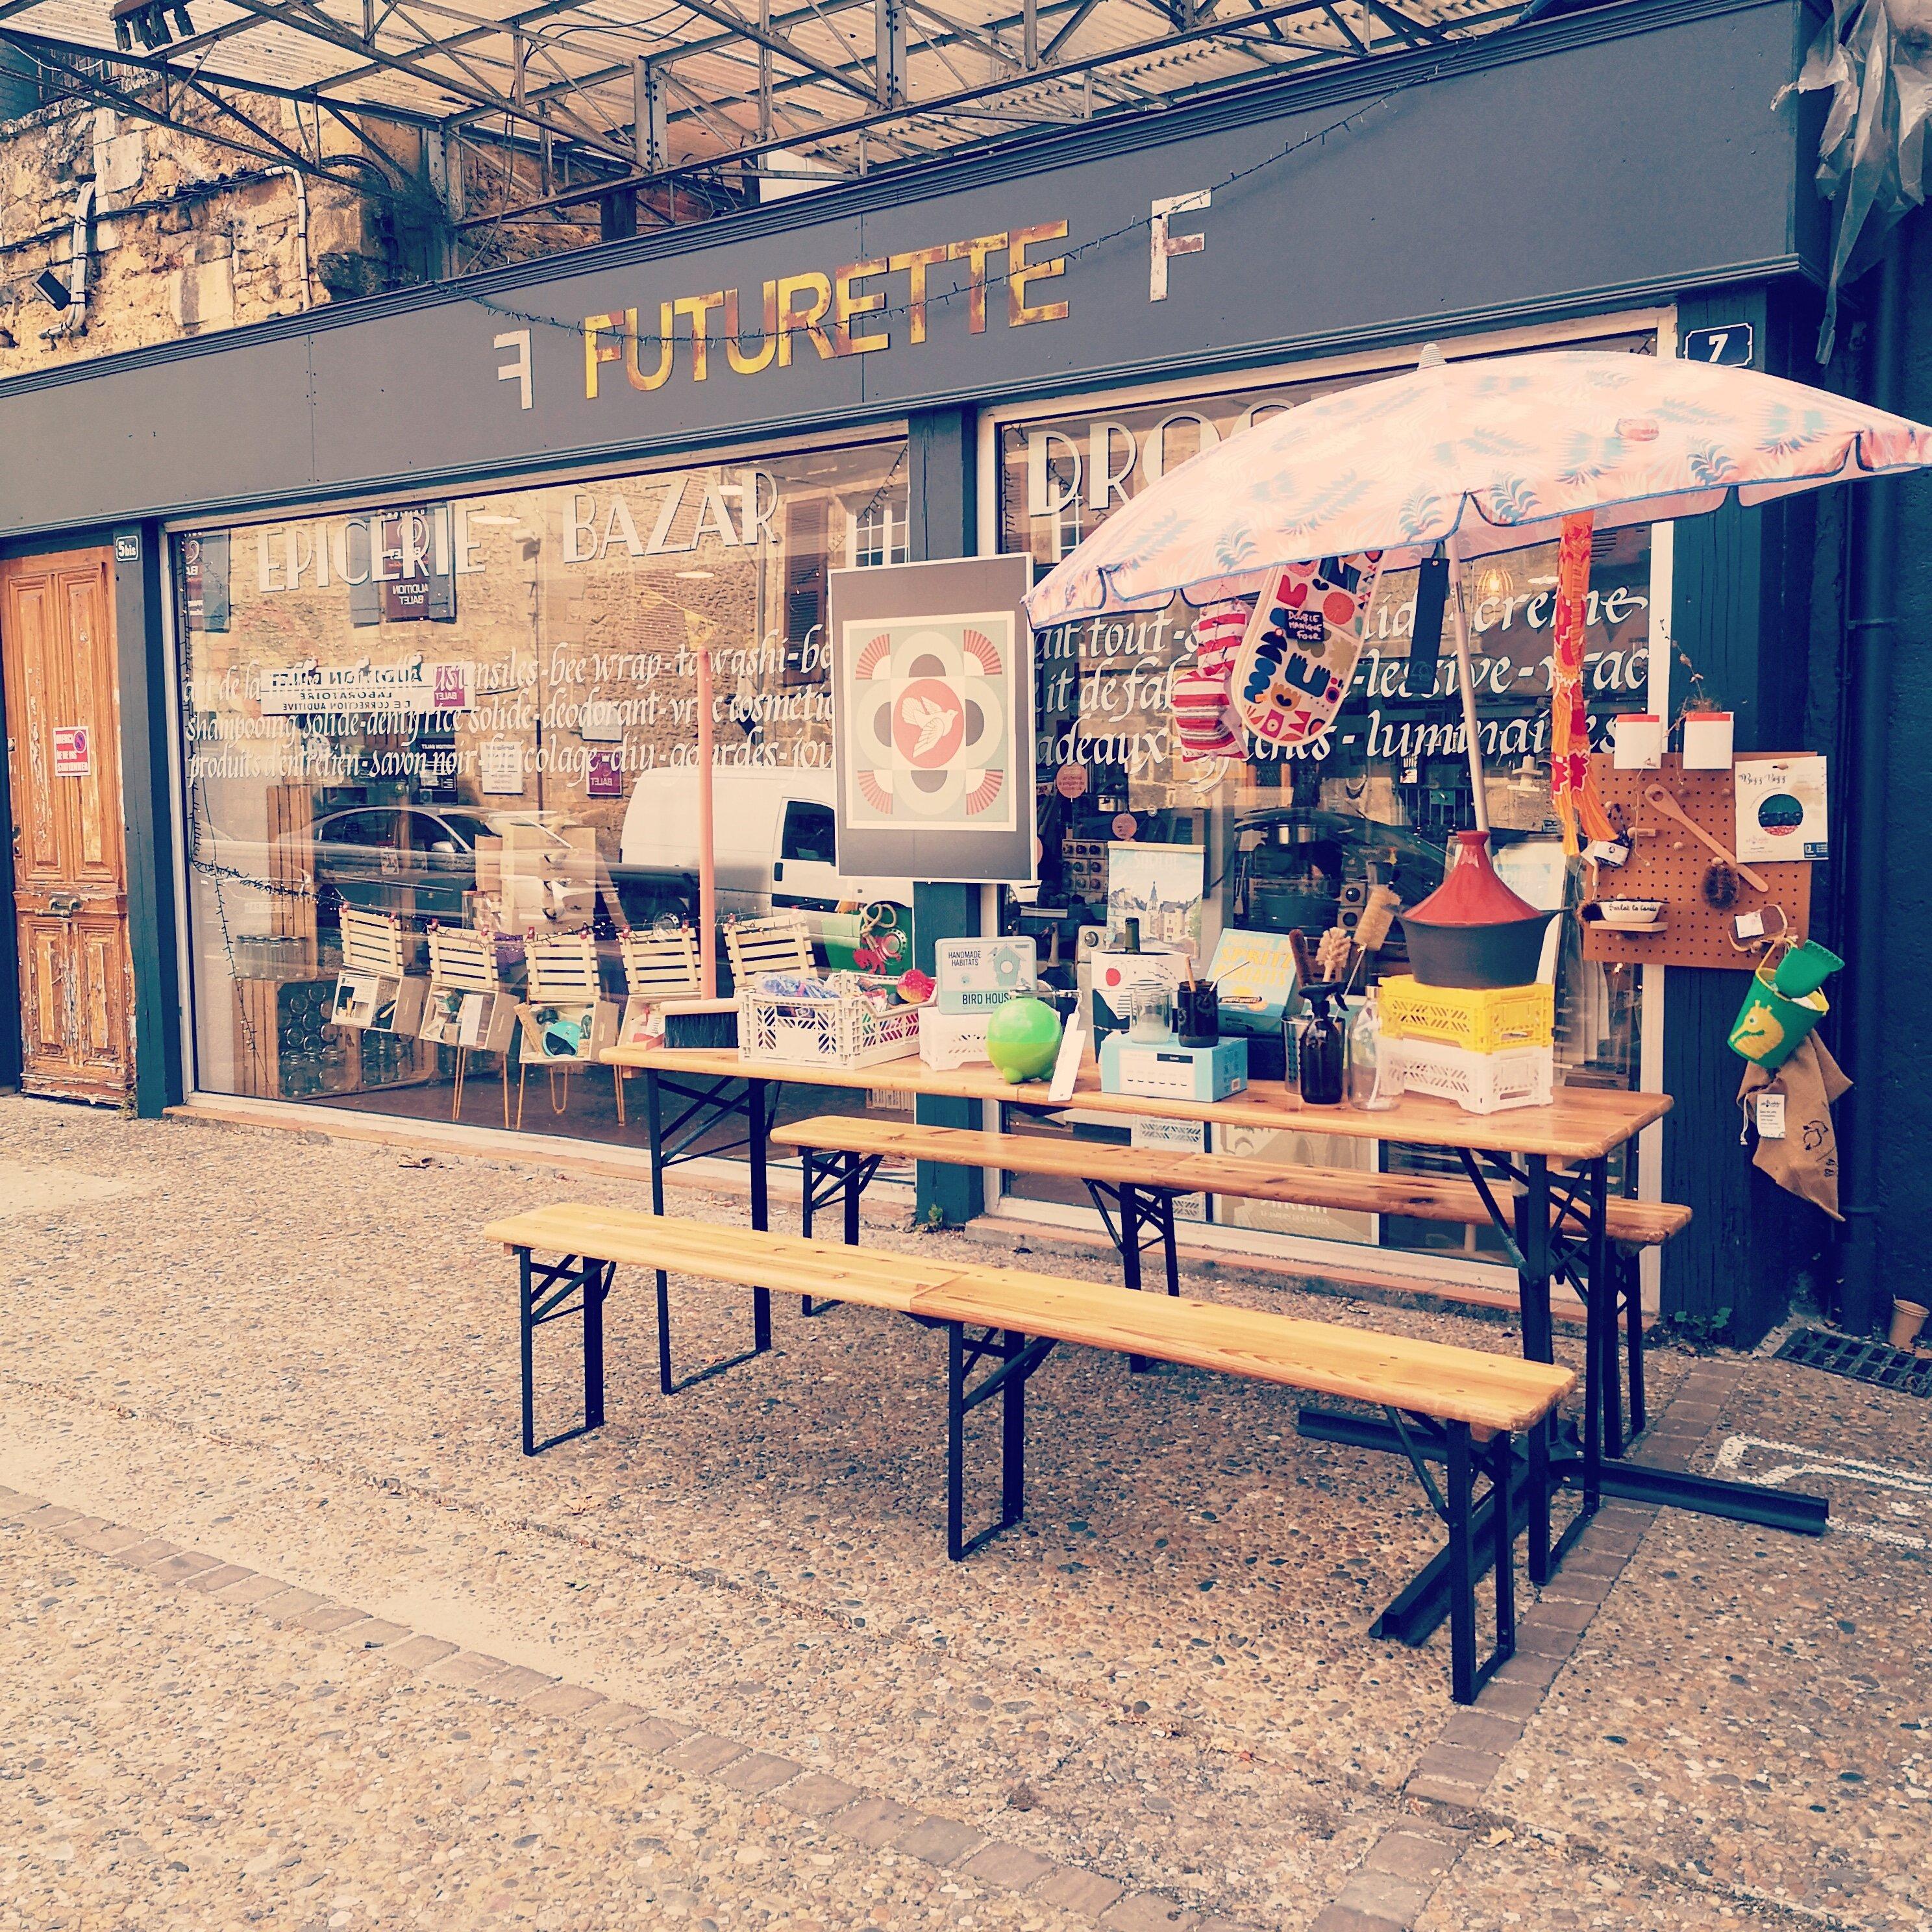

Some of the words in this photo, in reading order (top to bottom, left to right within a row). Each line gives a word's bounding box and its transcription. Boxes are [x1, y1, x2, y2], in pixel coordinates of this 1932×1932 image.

[585, 219, 1069, 399] FUTURETTE
[1149, 188, 1212, 303] F
[1709, 333, 1729, 363] 7
[258, 500, 486, 593] EPICERIE
[563, 467, 779, 564] BAZAR
[219, 665, 240, 702] de
[186, 705, 298, 749] shampooing
[188, 741, 261, 788] produits
[948, 950, 981, 960] HANDMADE
[952, 958, 978, 967] HABITATS
[962, 993, 983, 1006] BIRD
